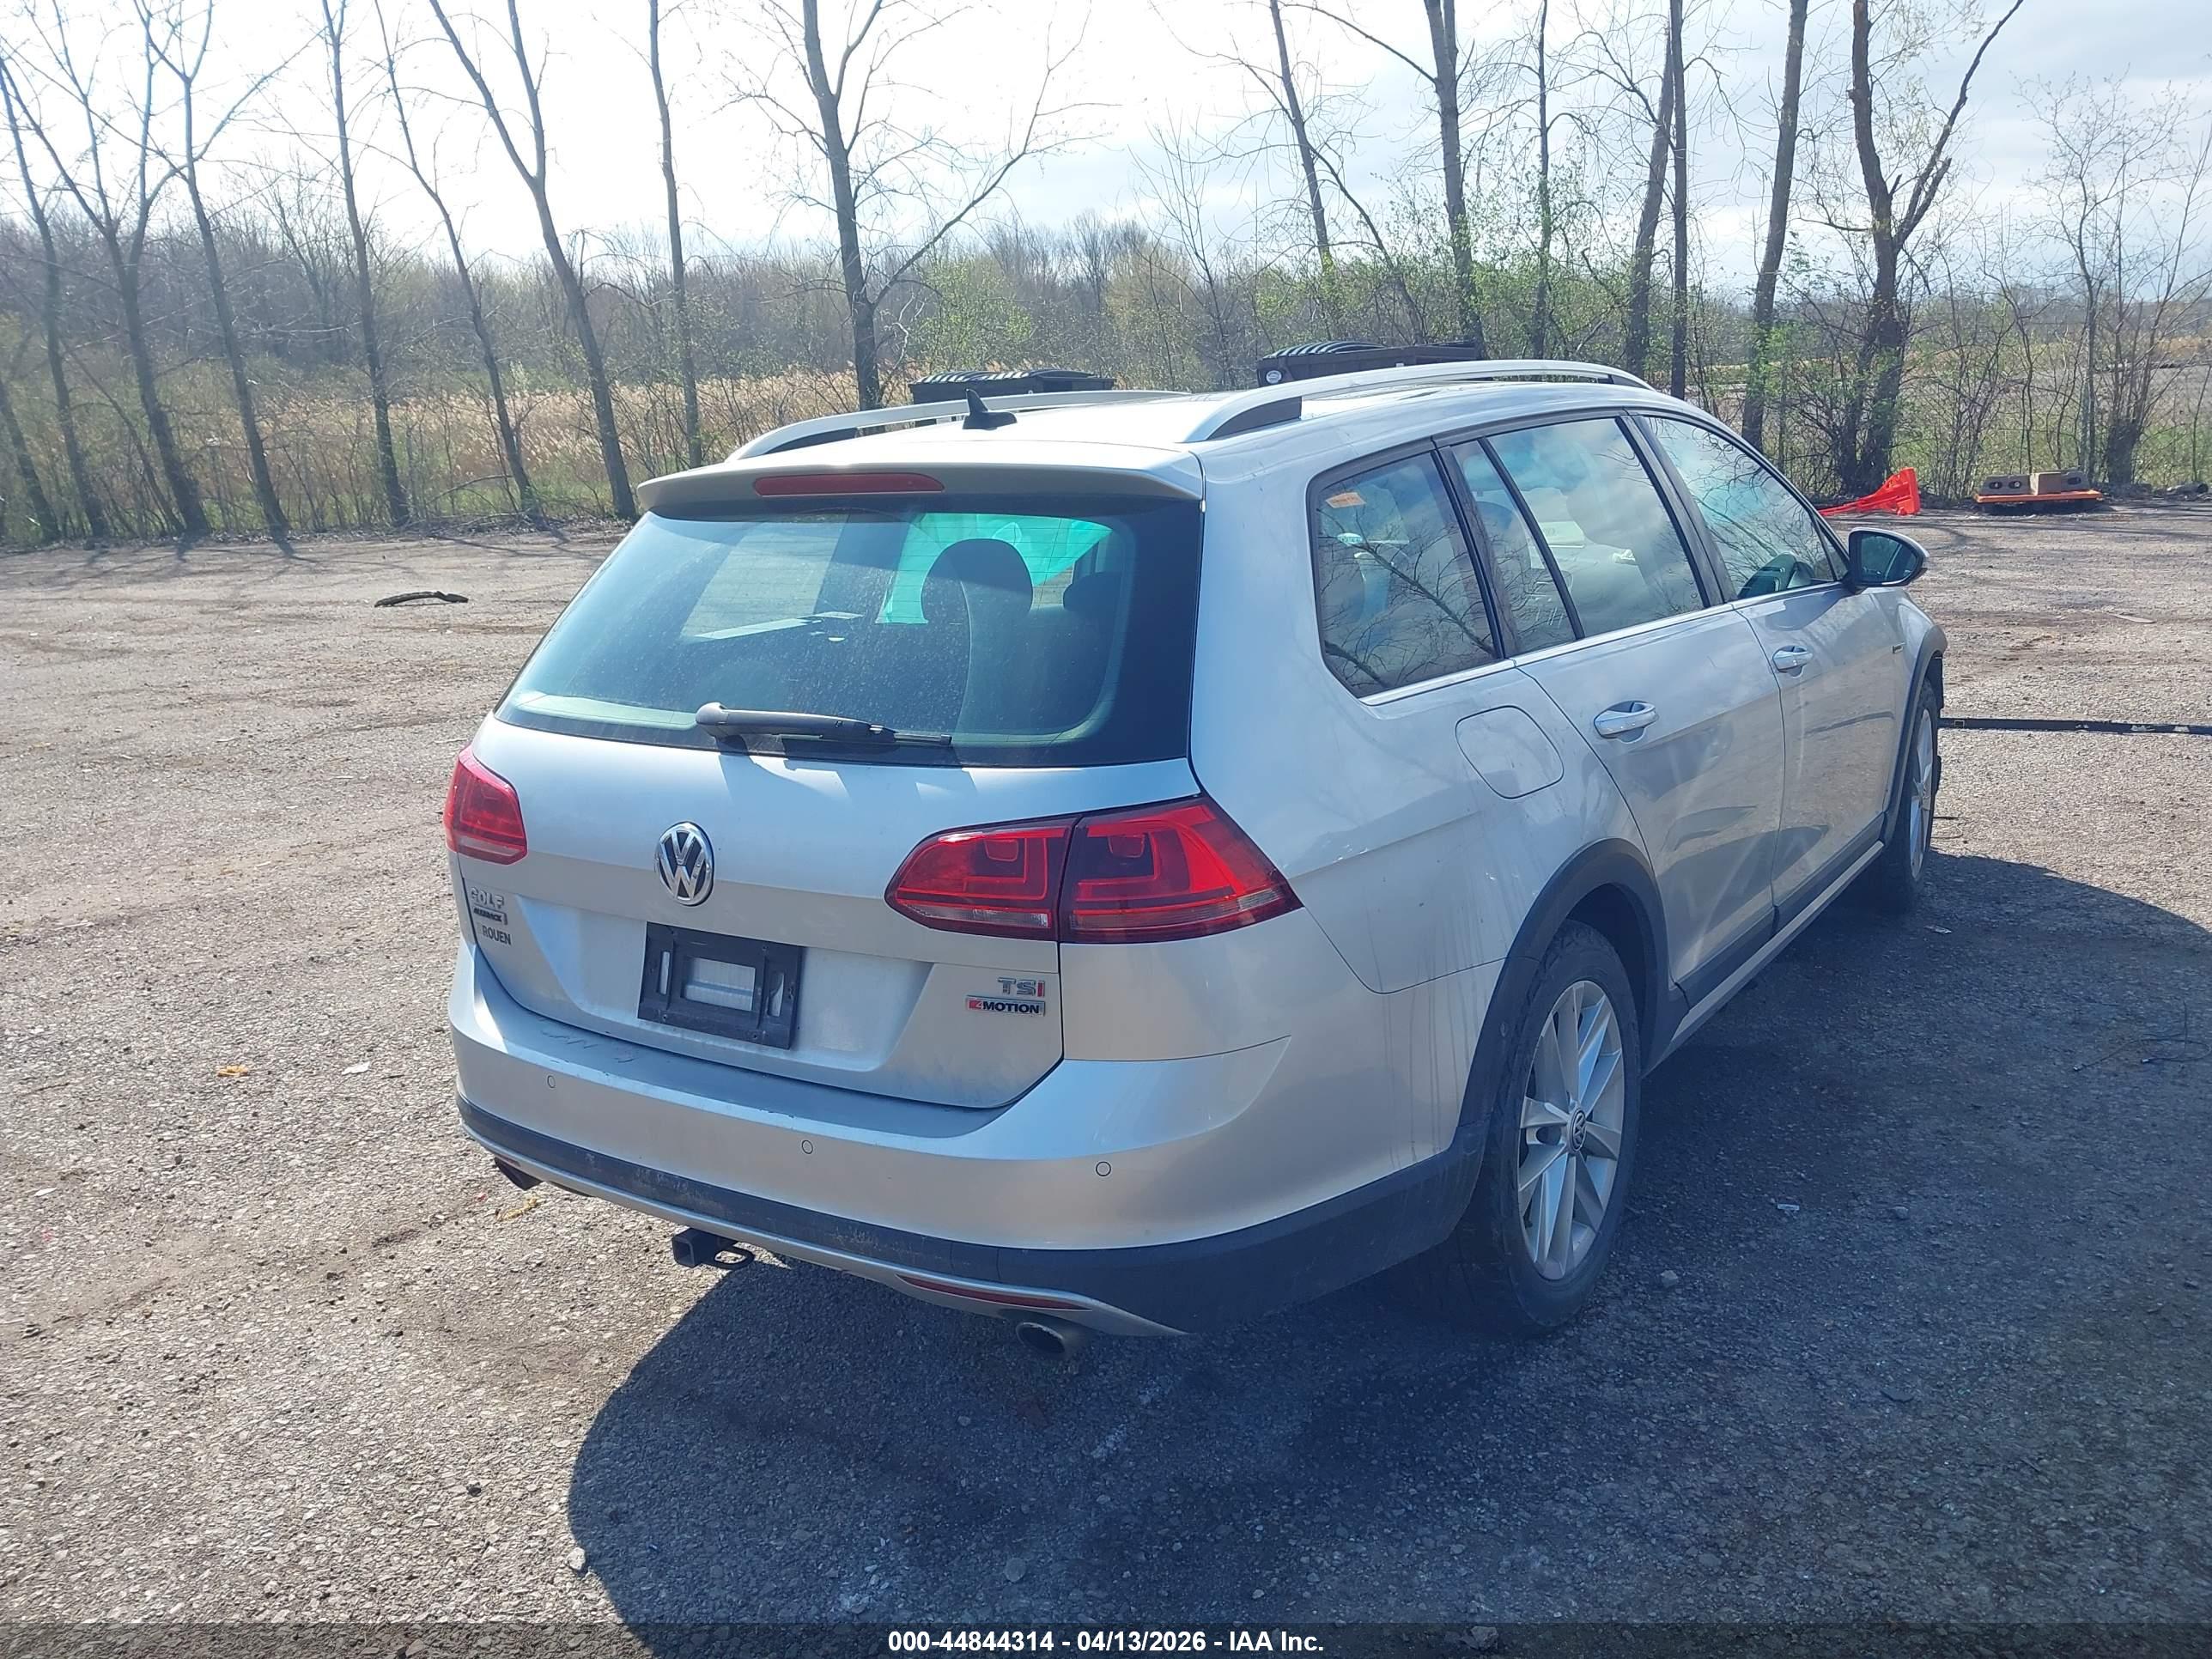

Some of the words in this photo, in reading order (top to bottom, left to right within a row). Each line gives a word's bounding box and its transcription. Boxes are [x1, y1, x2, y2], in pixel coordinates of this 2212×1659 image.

[657, 820, 714, 907] VW
[470, 886, 505, 909] GOLF
[482, 925, 512, 945] ROUEN
[997, 976, 1045, 997] TSI
